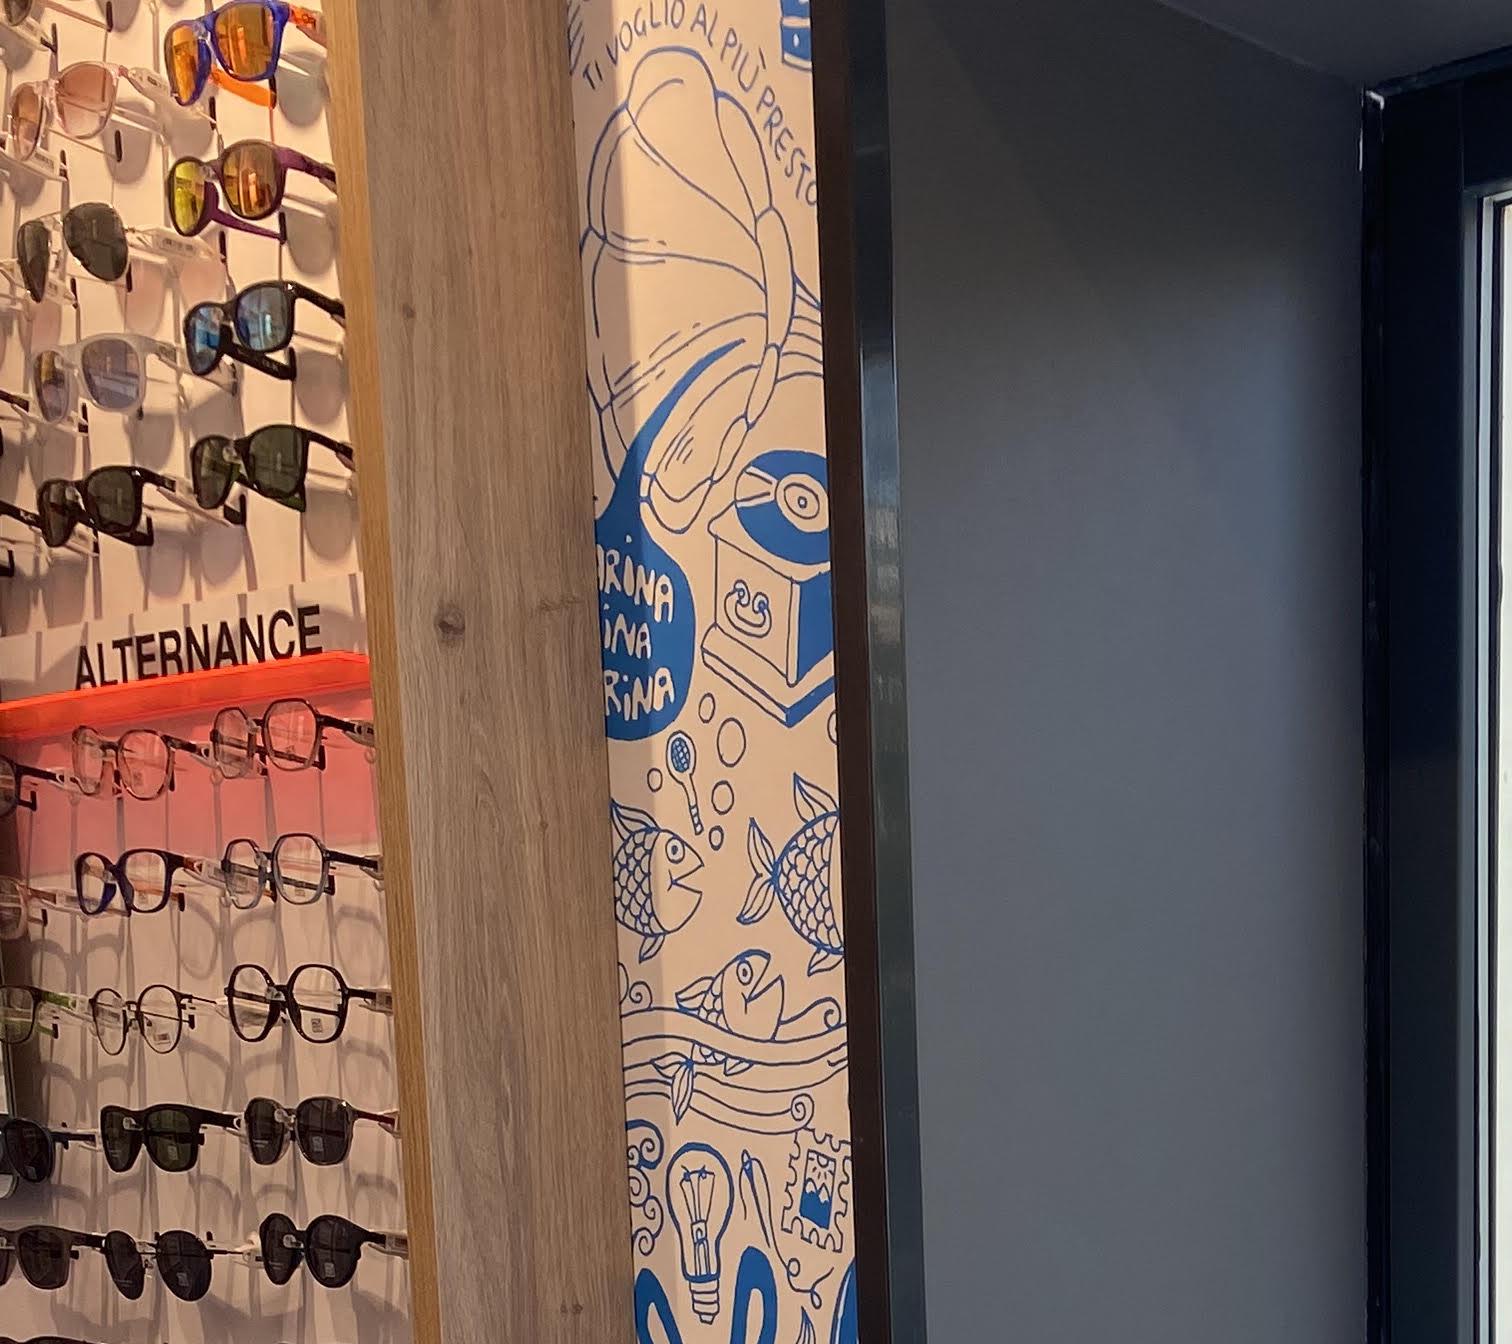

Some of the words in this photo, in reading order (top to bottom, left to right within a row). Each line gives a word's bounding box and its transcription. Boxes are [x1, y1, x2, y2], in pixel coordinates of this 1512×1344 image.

[583, 60, 603, 90] TI
[606, 0, 686, 66] VOGLIO
[690, 3, 718, 48] AL
[75, 604, 323, 690] ALTERNANCE
